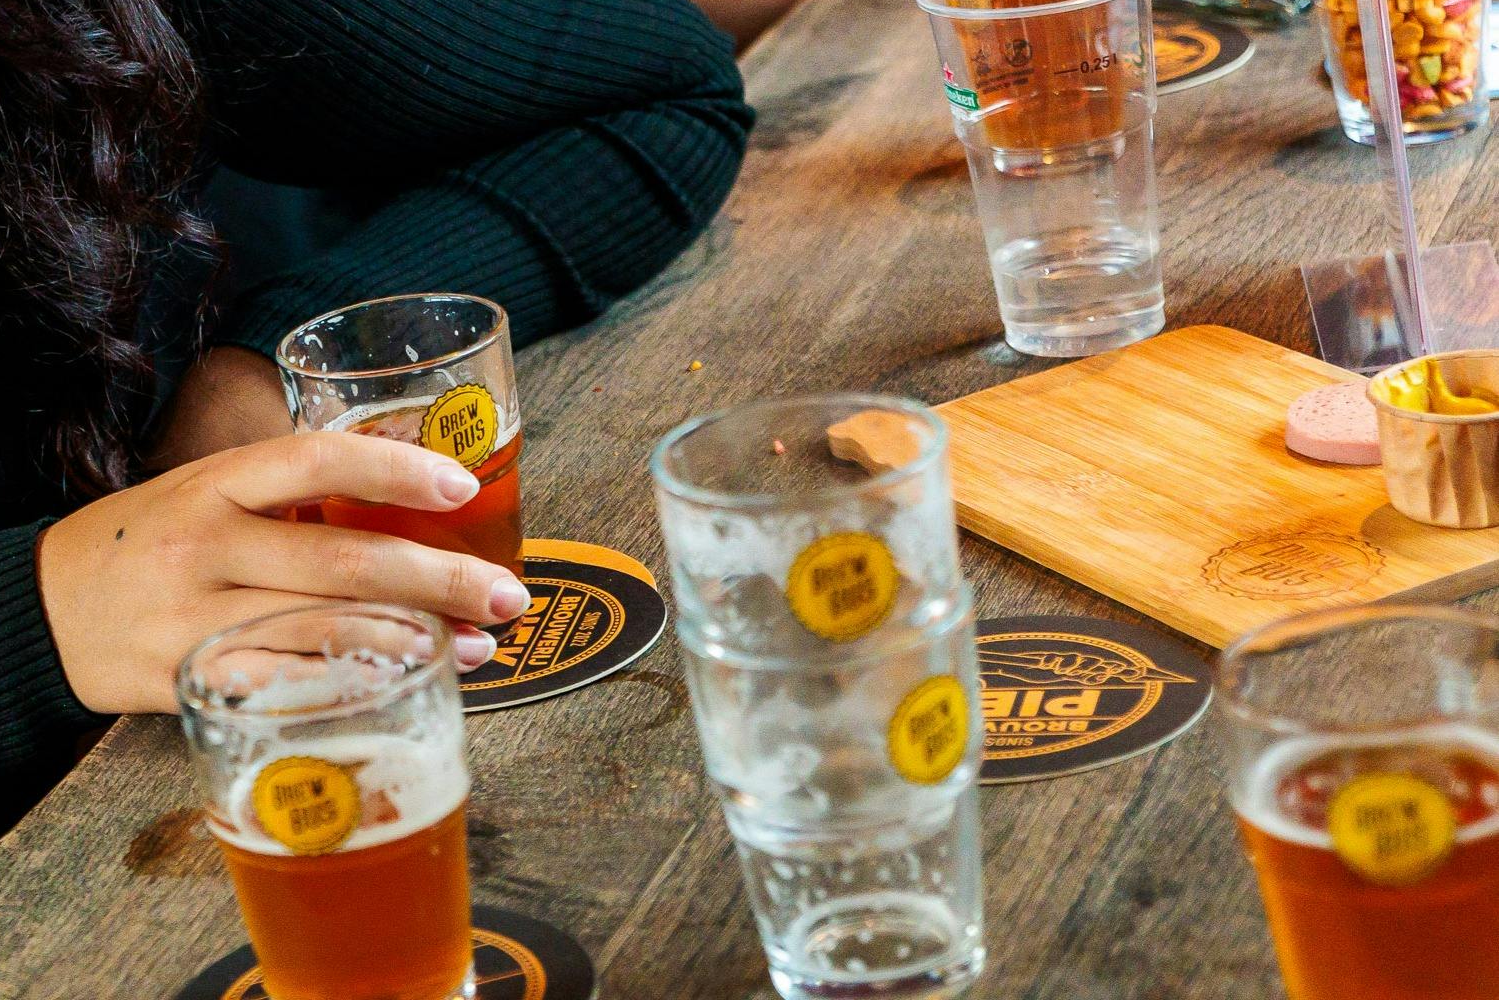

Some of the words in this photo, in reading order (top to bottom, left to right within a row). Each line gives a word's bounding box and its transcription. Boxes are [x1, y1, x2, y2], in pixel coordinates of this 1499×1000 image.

[439, 398, 479, 439] BREW
[453, 418, 485, 456] BUS
[528, 596, 581, 665] BROUWERIJ
[985, 737, 1034, 747] SINDS
